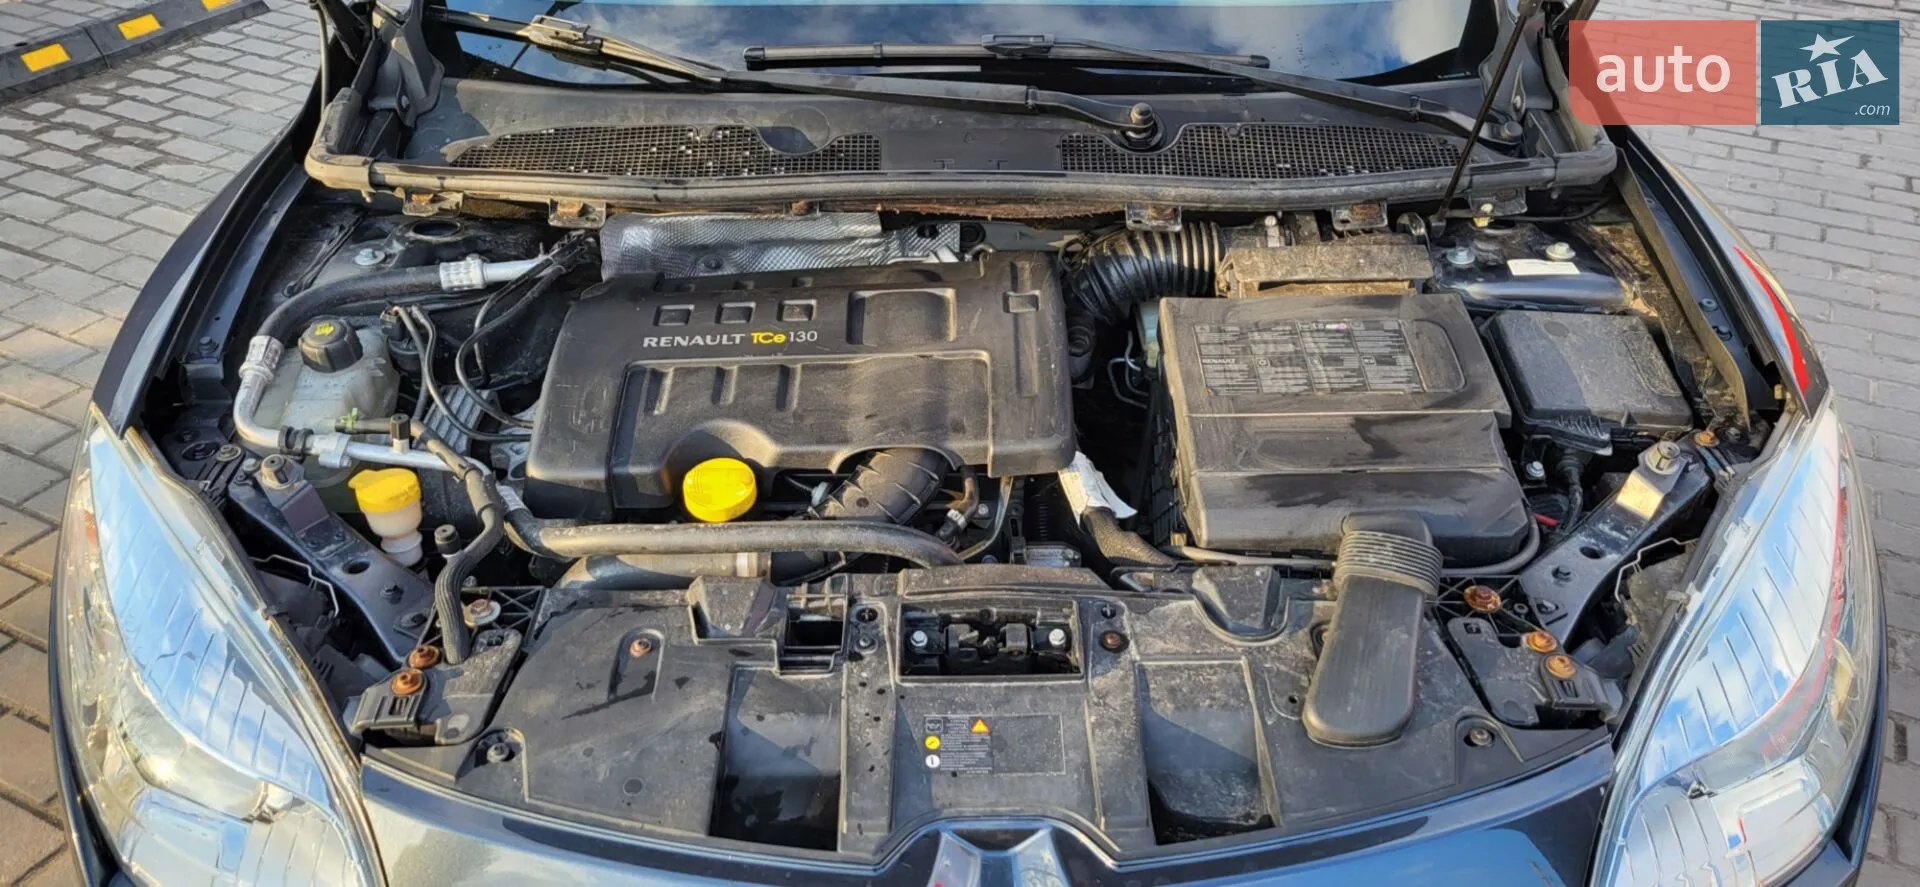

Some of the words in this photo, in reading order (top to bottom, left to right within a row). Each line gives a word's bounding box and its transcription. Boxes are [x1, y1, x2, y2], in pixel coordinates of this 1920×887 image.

[643, 333, 746, 348] RENAULT
[751, 332, 787, 344] TCe
[789, 330, 818, 342] 130
